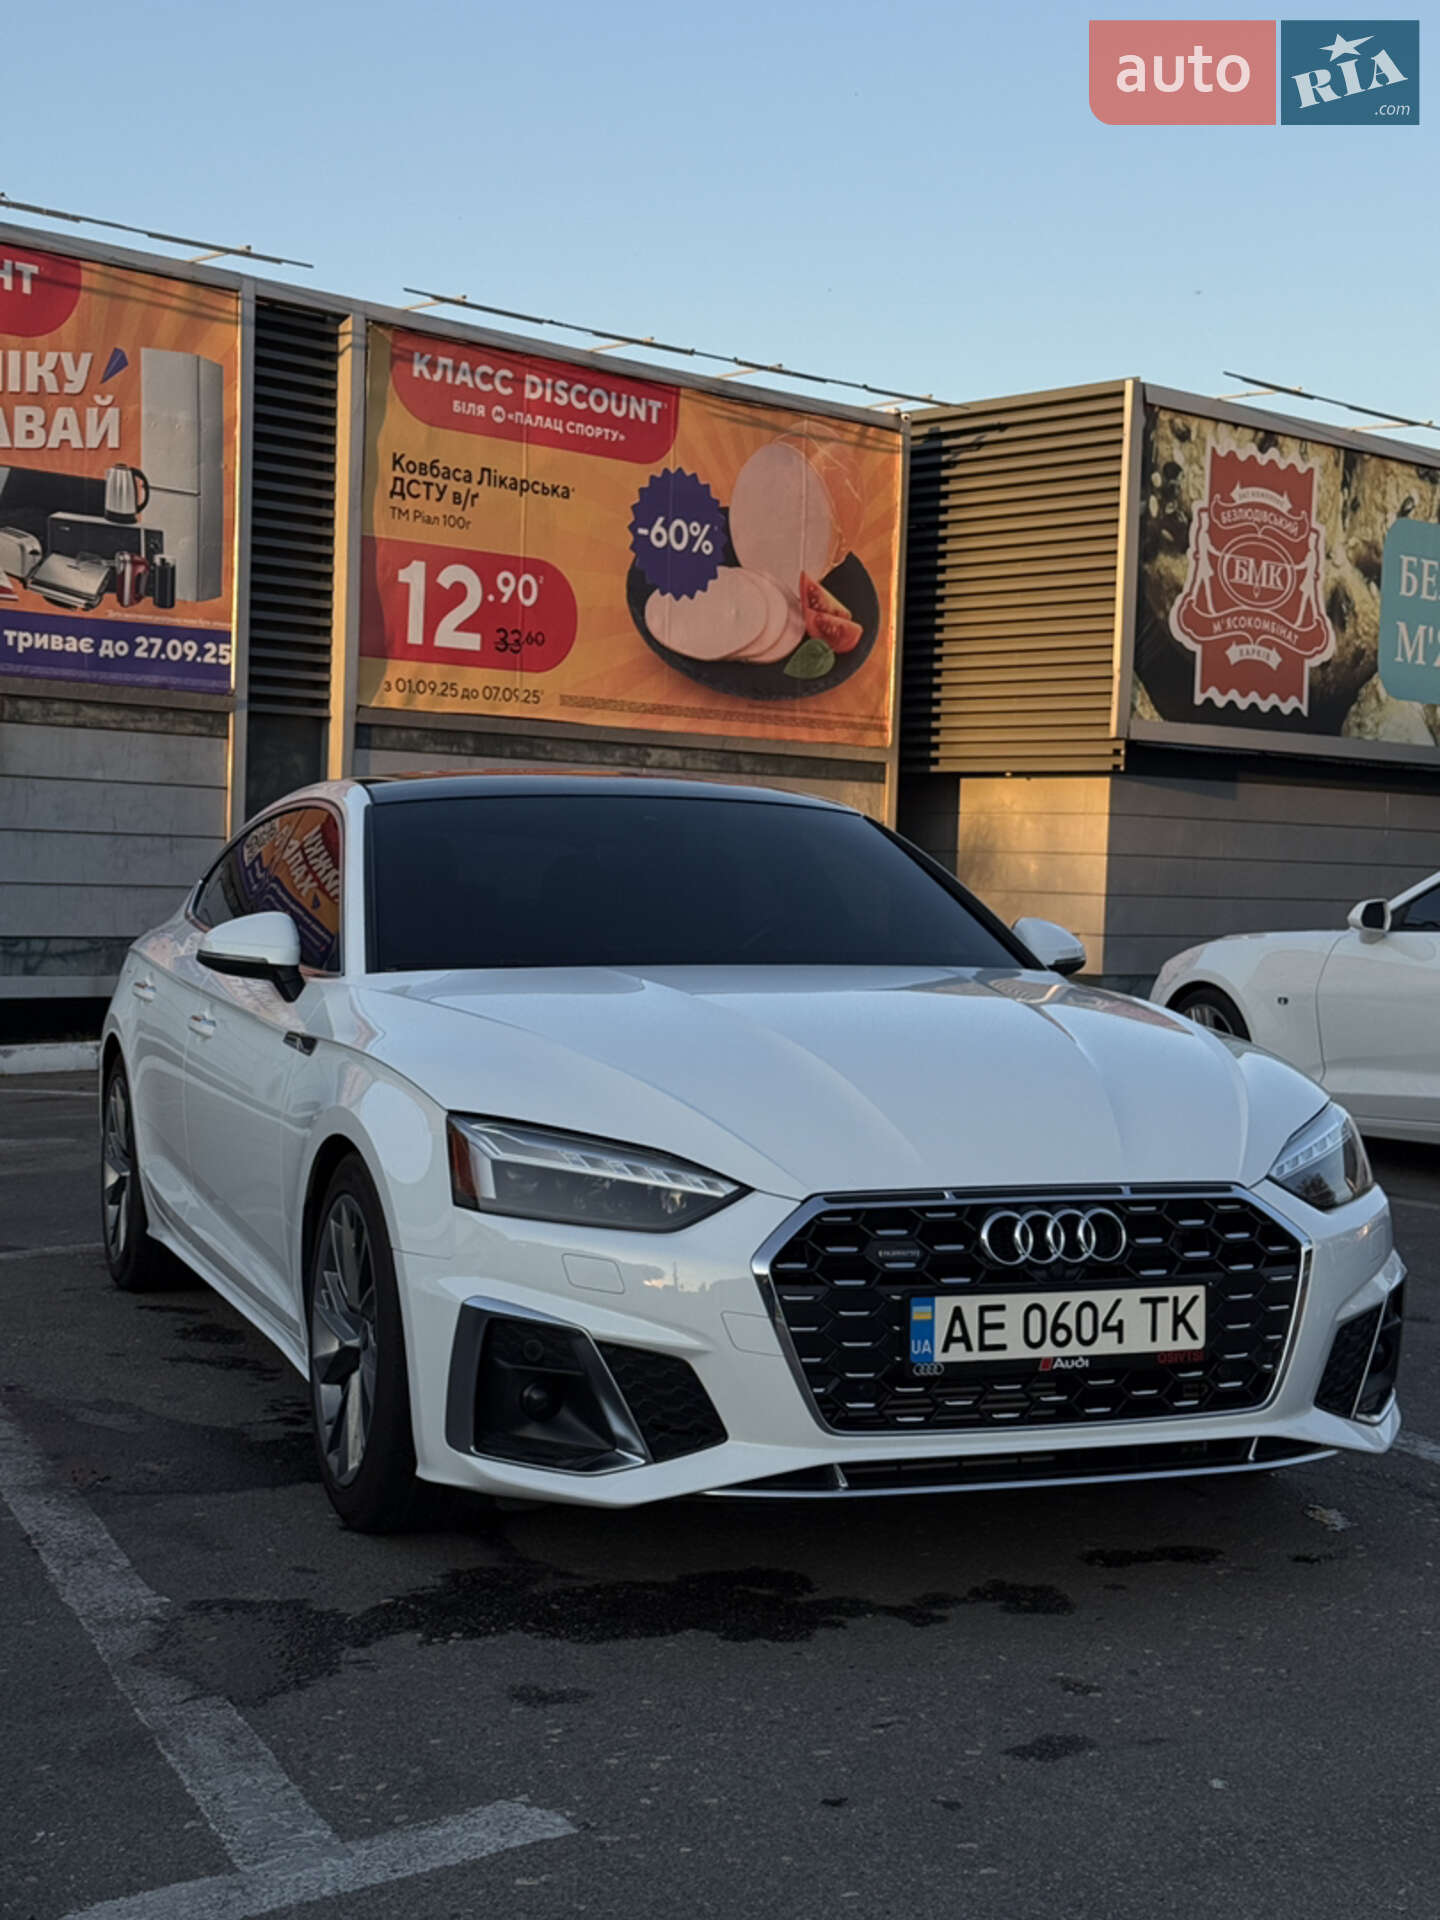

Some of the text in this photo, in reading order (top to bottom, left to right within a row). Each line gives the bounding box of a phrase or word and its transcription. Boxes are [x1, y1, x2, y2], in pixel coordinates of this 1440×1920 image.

[0, 350, 93, 394] ІКУ
[412, 352, 662, 424] КЛАСС DISCOUNT
[452, 399, 486, 418] БІЛЯ
[392, 452, 473, 484] Ковбаса
[389, 476, 449, 502] ДСТУ
[389, 506, 472, 530] ТМ Ріал 100г
[637, 516, 714, 556] -60%
[1230, 556, 1285, 591] БМК
[1399, 554, 1440, 601] БЕ
[4, 628, 232, 666] триває до 27.09.25
[1393, 621, 1440, 668] М'
[395, 678, 459, 698] 01.09.25
[461, 688, 479, 701] до
[941, 1294, 1201, 1353] AE 0604 TK
[911, 1339, 932, 1355] UA
[1053, 1356, 1090, 1369] Audi
